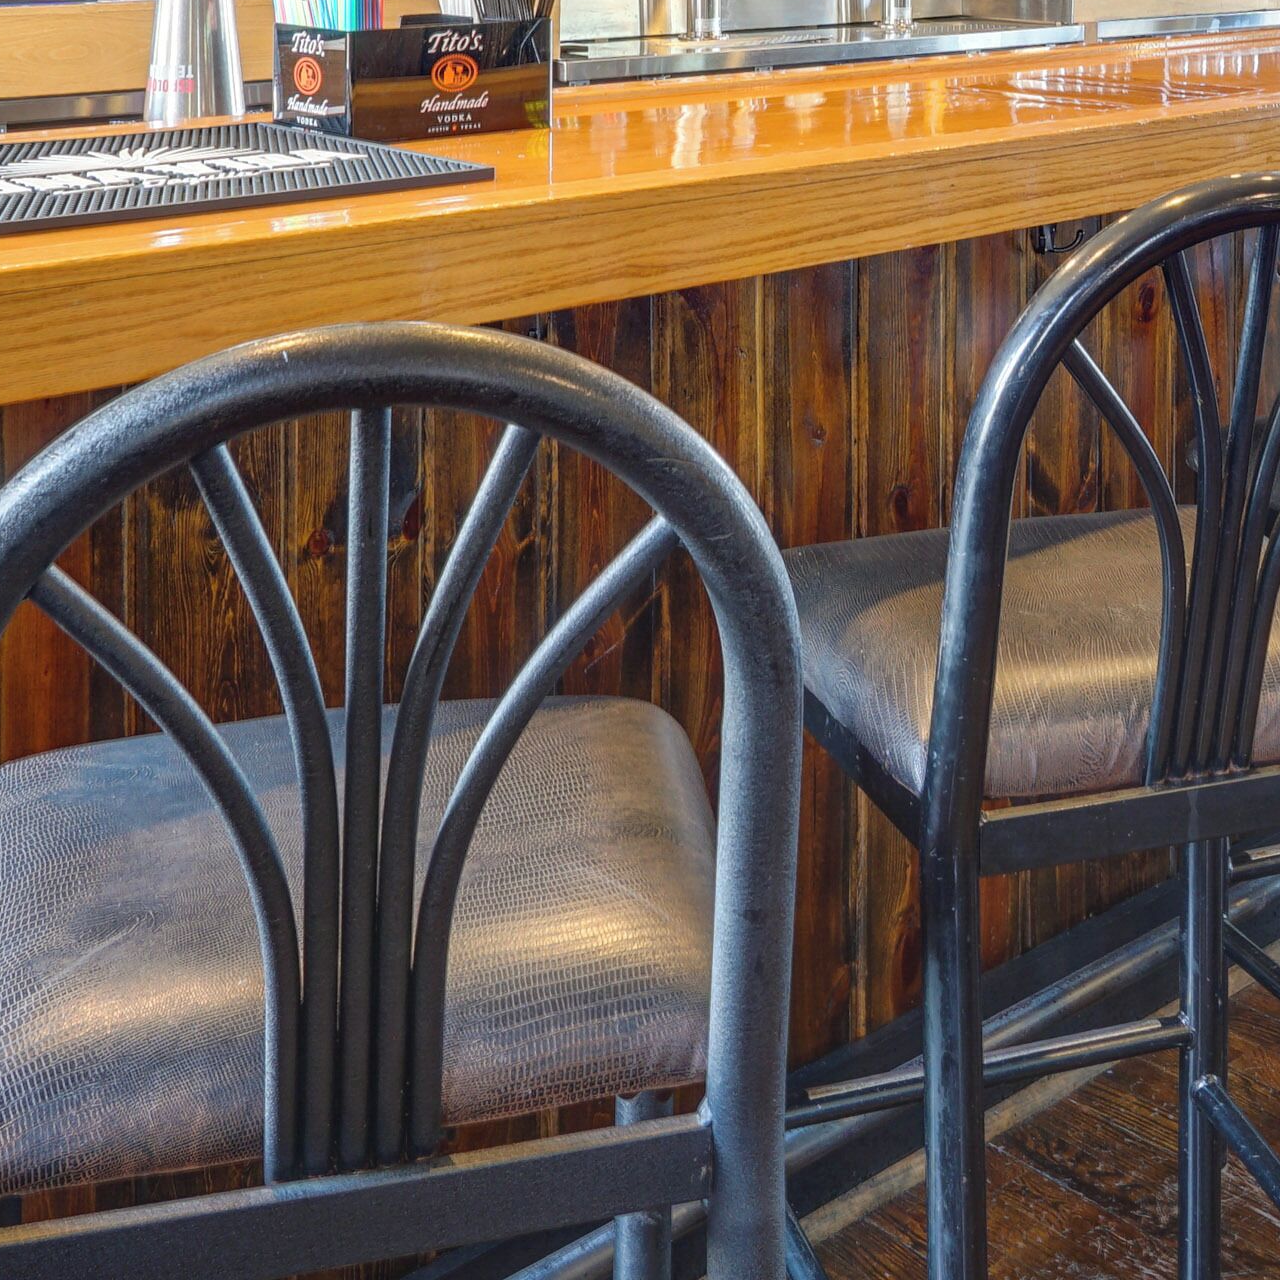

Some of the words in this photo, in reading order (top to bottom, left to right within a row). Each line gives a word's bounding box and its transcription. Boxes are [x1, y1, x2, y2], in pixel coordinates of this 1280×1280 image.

[287, 93, 329, 116] Handmade
[420, 90, 490, 114] Handmade
[296, 116, 318, 127] VODKA
[437, 113, 473, 124] VODKA
